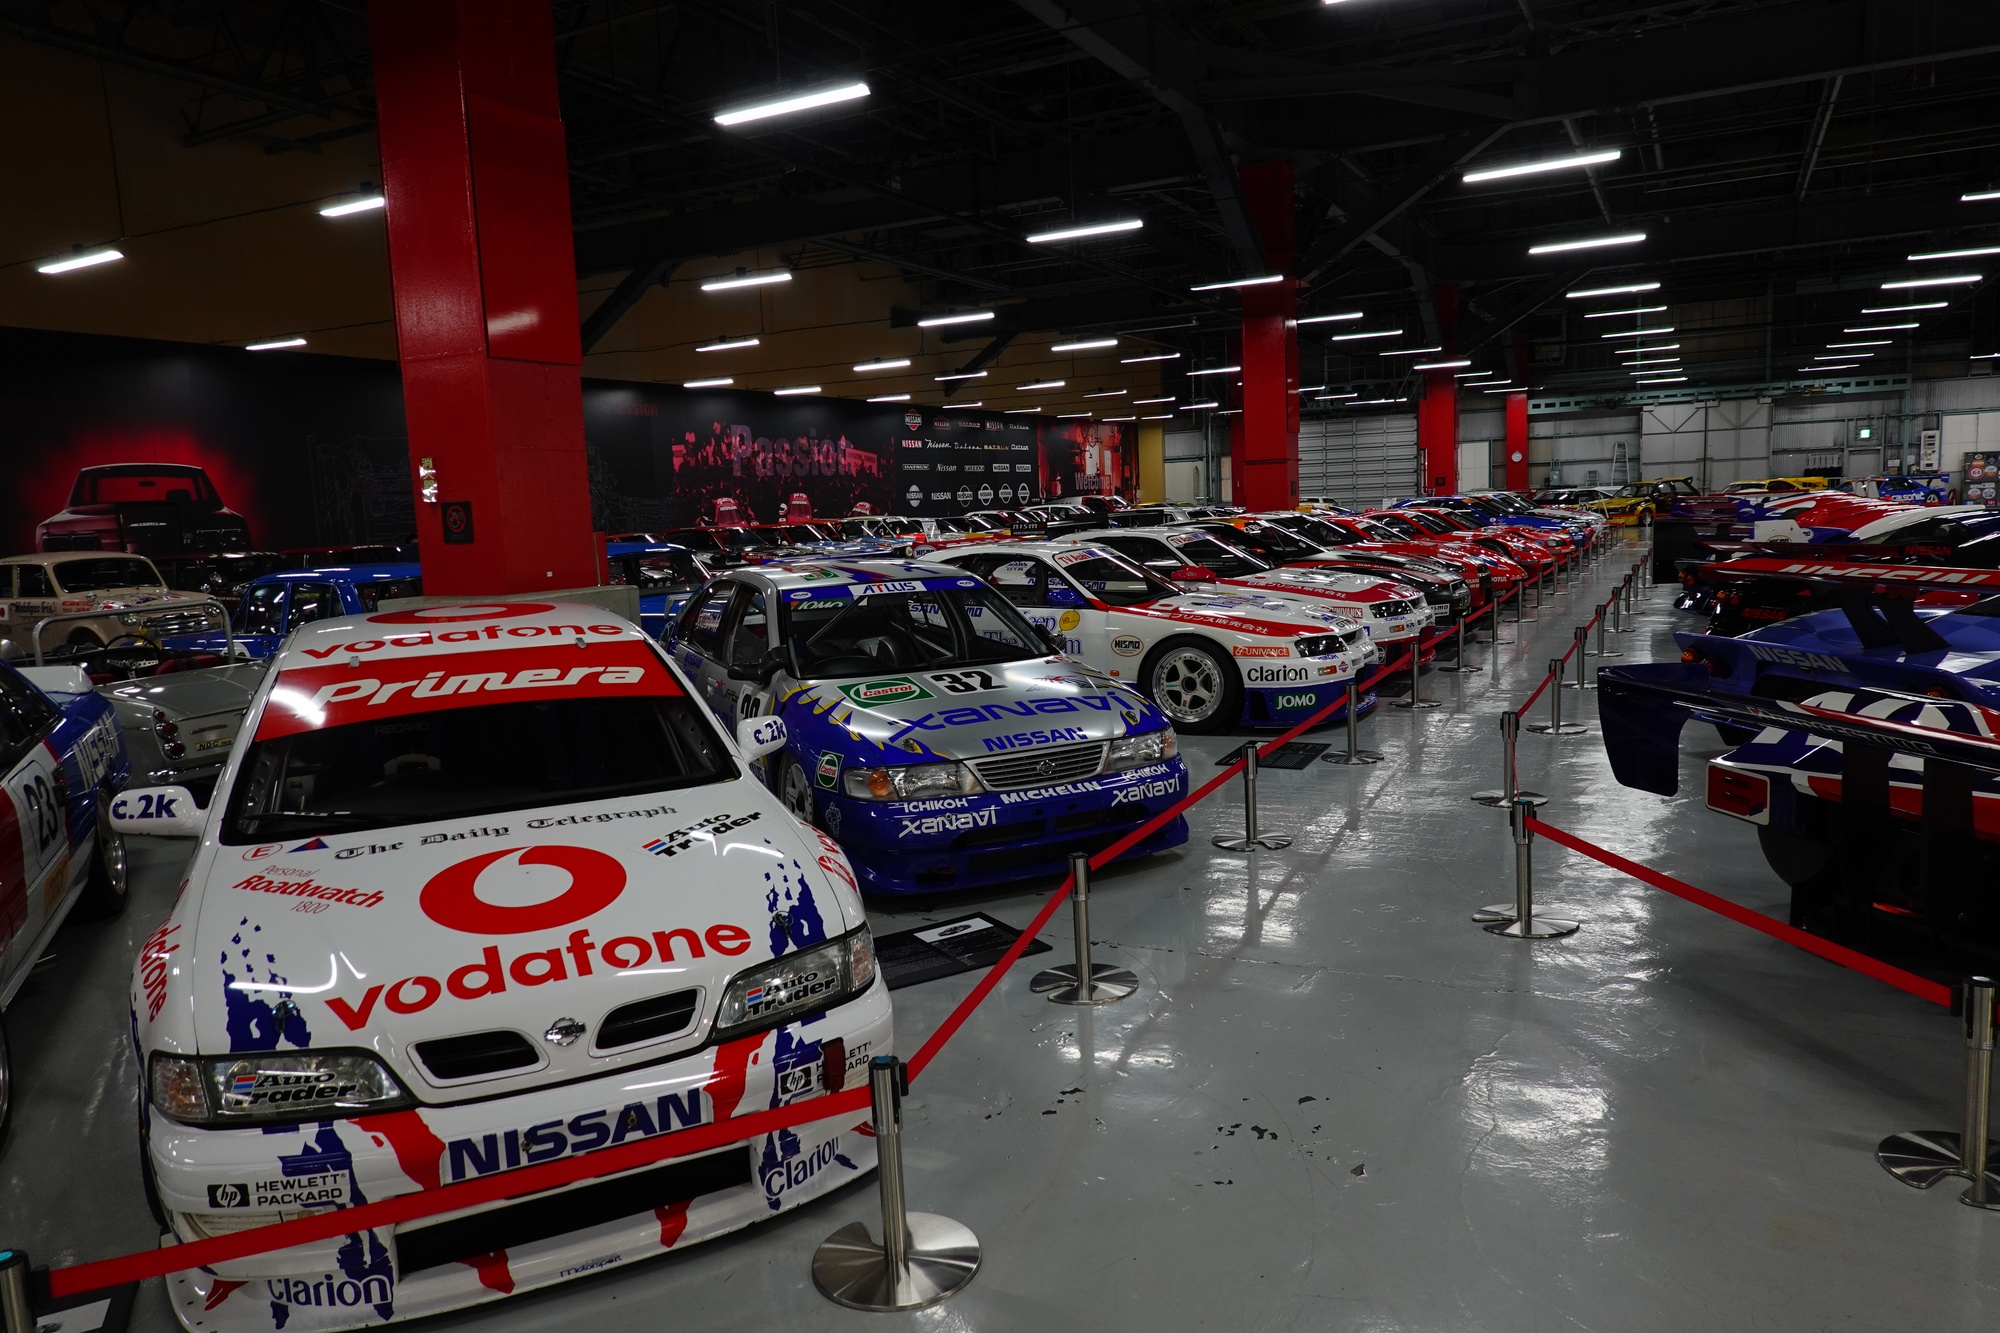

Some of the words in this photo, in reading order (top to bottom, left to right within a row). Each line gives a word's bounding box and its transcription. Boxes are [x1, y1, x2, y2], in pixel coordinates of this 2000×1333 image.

[730, 424, 855, 477] Passion
[901, 439, 922, 448] NISSAN
[931, 492, 952, 500] NISSAN
[1904, 545, 1953, 556] NISSAN
[1739, 608, 1788, 620] NISSAN
[301, 622, 623, 659] vodafone
[1114, 640, 1141, 650] NISMO
[1246, 647, 1289, 656] UNIVANCE
[1748, 645, 1849, 673] NISSAN
[295, 665, 646, 718] Primera
[863, 685, 914, 698] Castrol
[930, 670, 1009, 693] 32
[1276, 693, 1316, 711] JOMO
[374, 720, 430, 735] RECARO
[888, 690, 1135, 744] xanavi
[72, 711, 120, 792] NISSAN
[982, 727, 1088, 752] NISSAN
[820, 765, 837, 777] Castrol
[1000, 781, 1102, 806] MICHELIN
[1111, 773, 1181, 808] xanavi
[23, 775, 59, 856] 23
[112, 794, 178, 821] c.2k
[903, 797, 969, 814] ICHIKOH
[335, 839, 404, 860] The
[420, 825, 511, 848] Daily
[526, 805, 679, 830] Telegraph
[654, 810, 763, 858] Trader
[664, 812, 732, 843] Auto
[898, 806, 998, 839] xanavi
[259, 864, 322, 878] Personal
[233, 875, 385, 909] Roadwatch
[291, 901, 330, 914] 1800
[325, 923, 752, 1032] vodafone
[763, 970, 819, 997] Auto
[747, 975, 837, 1017] Trader
[255, 1071, 336, 1088] Auto
[447, 1088, 700, 1182] NISSAN
[214, 1183, 239, 1208] hp
[255, 1174, 340, 1193] HEWLETT
[257, 1187, 343, 1206] PACKARD
